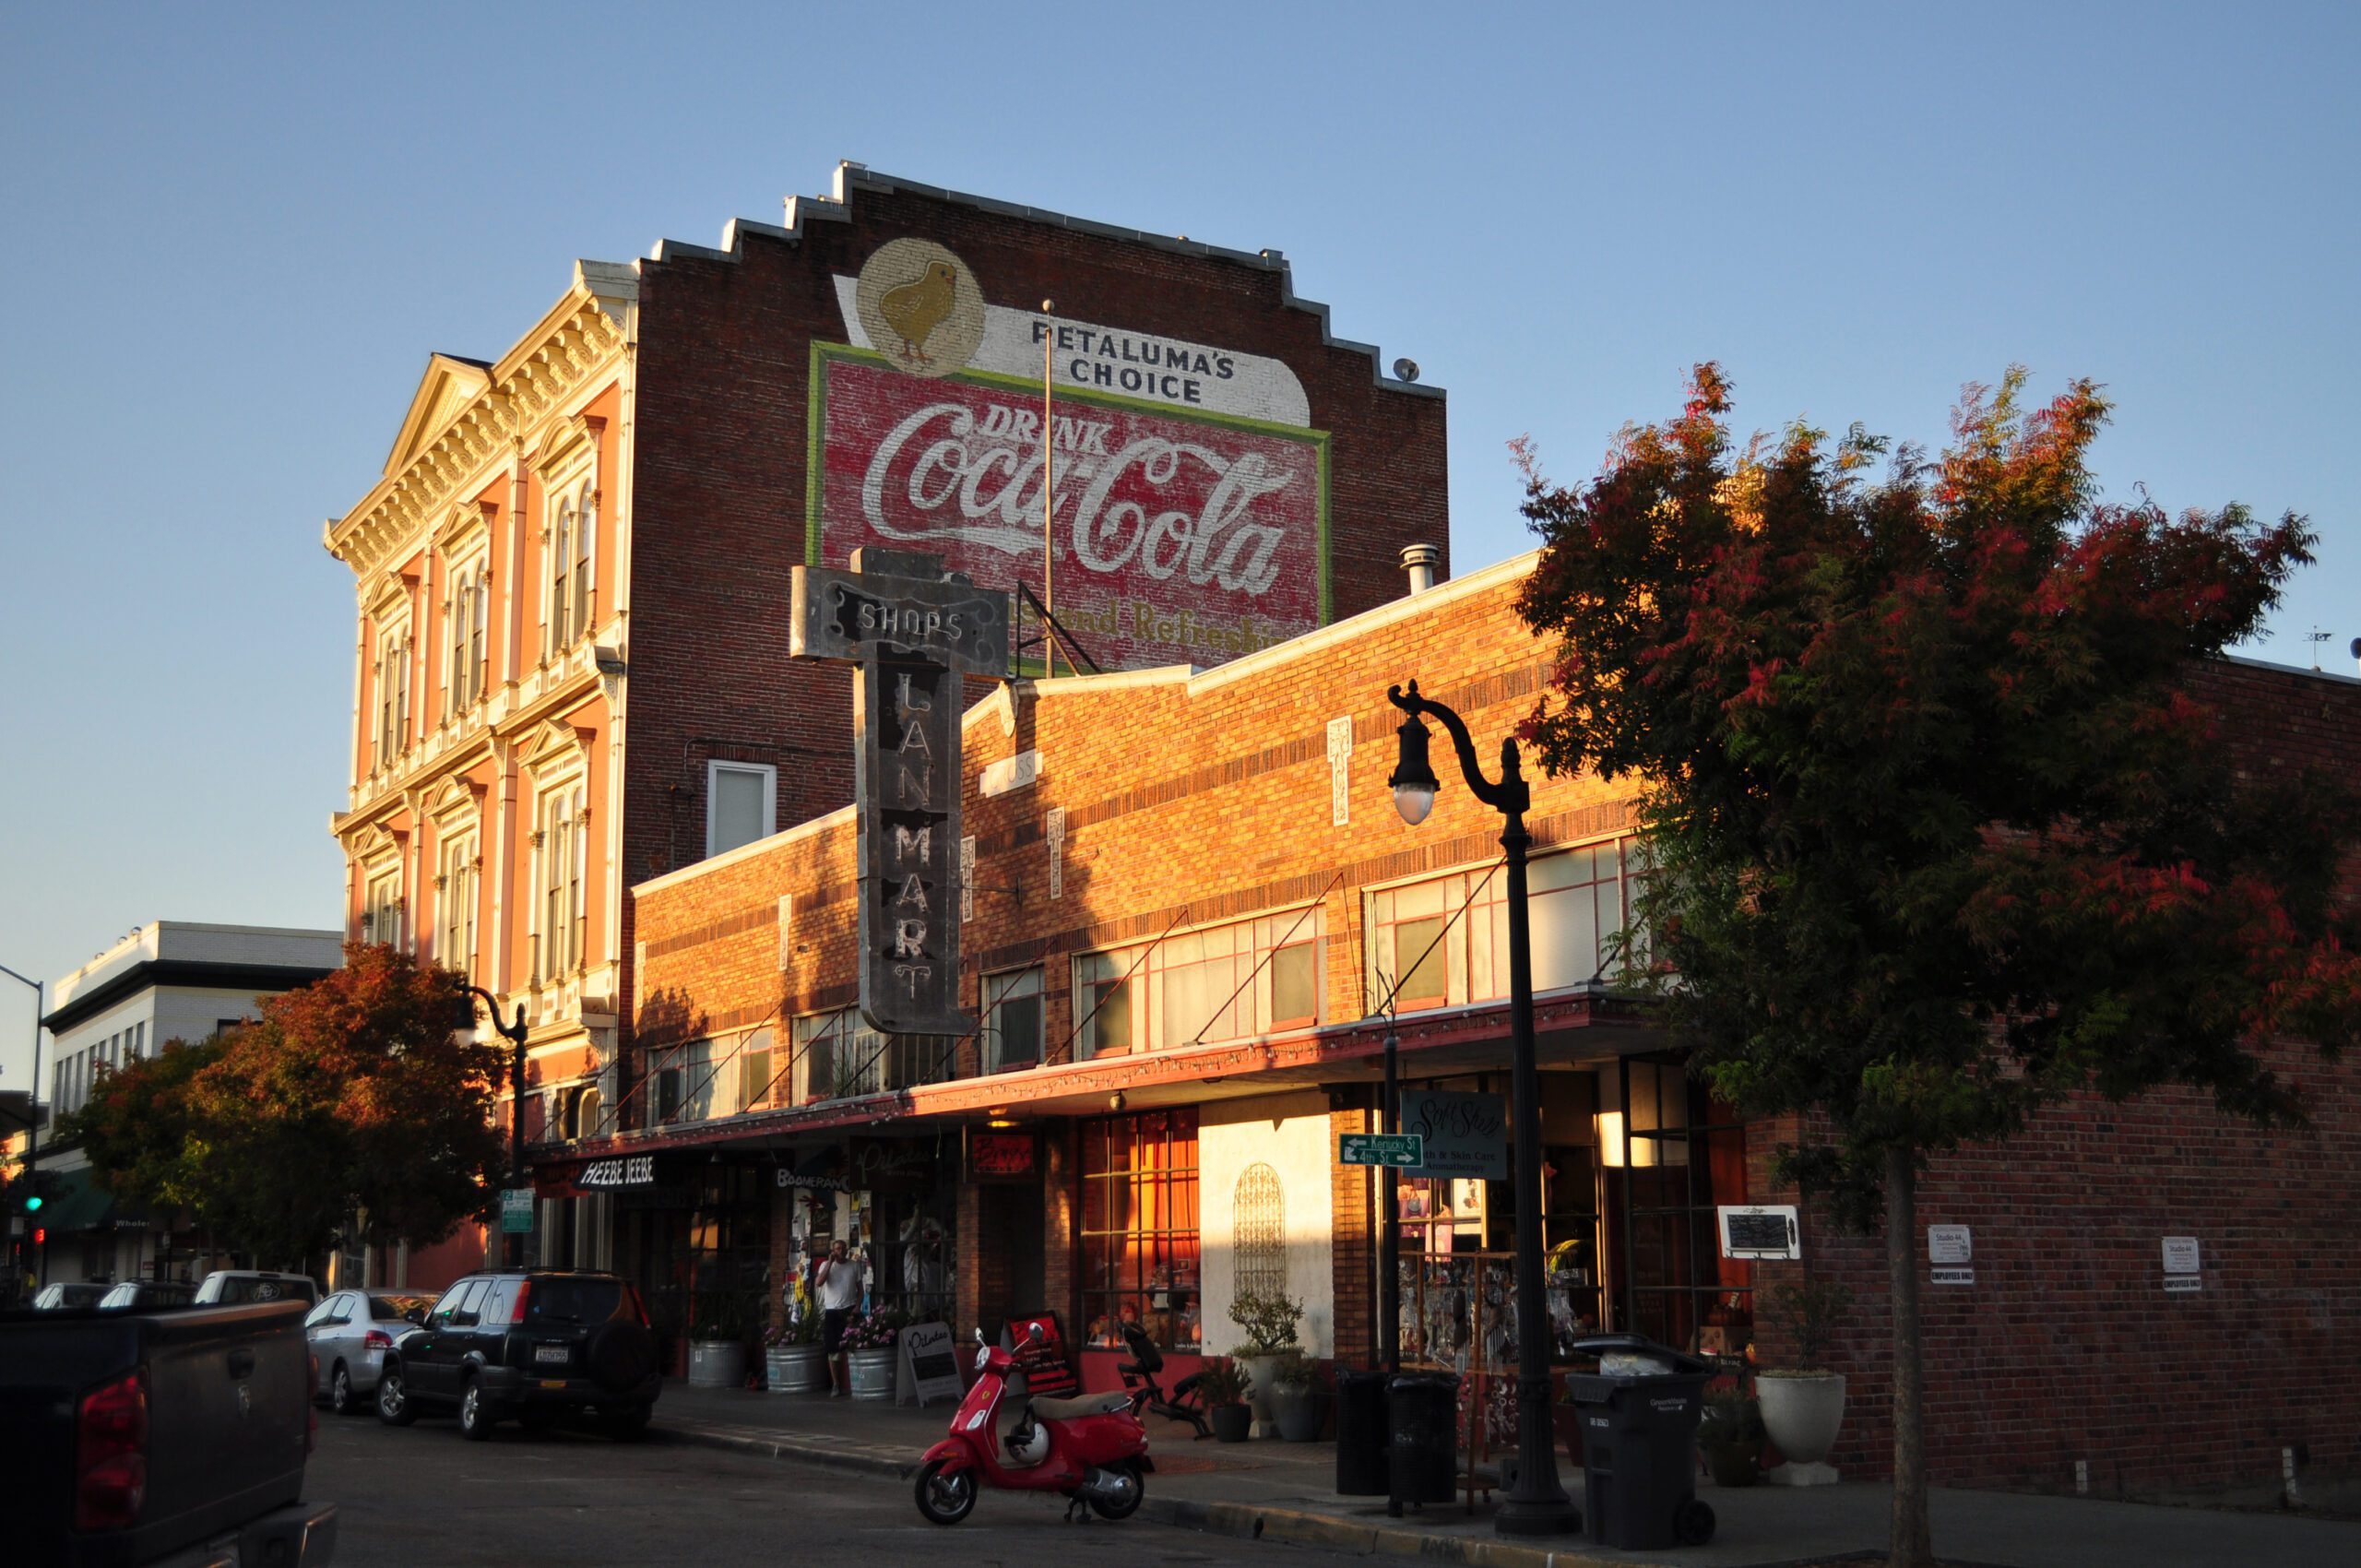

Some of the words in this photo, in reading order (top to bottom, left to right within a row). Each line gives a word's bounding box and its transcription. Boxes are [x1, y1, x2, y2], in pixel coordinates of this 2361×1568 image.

[1032, 321, 1234, 379] PETALUMA'S
[1070, 359, 1202, 404] CHOICE
[978, 404, 1112, 456] DRINK
[862, 403, 1295, 597] Coca-Cola
[861, 602, 963, 640] SHOPS
[1053, 600, 1120, 636] and
[1132, 601, 1287, 652] Refreshi
[1370, 1135, 1406, 1152] Kentucky
[1406, 1136, 1416, 1150] St
[1440, 1151, 1447, 1159] &
[1451, 1150, 1471, 1159] Skin
[1475, 1151, 1496, 1160] Care
[580, 1159, 623, 1184] HEEBE
[625, 1156, 654, 1183] JEEBE
[1359, 1150, 1375, 1163] 4th
[1380, 1151, 1390, 1164] St
[1426, 1162, 1484, 1174] Aromatherapy
[1936, 1233, 1954, 1241] Studio
[1932, 1272, 1961, 1280] EMPLOYEES
[1962, 1272, 1973, 1280] ONLY
[2164, 1280, 2189, 1289] EMPLOYEES
[2189, 1279, 2201, 1288] ONLY
[908, 1330, 948, 1356] Pilates
